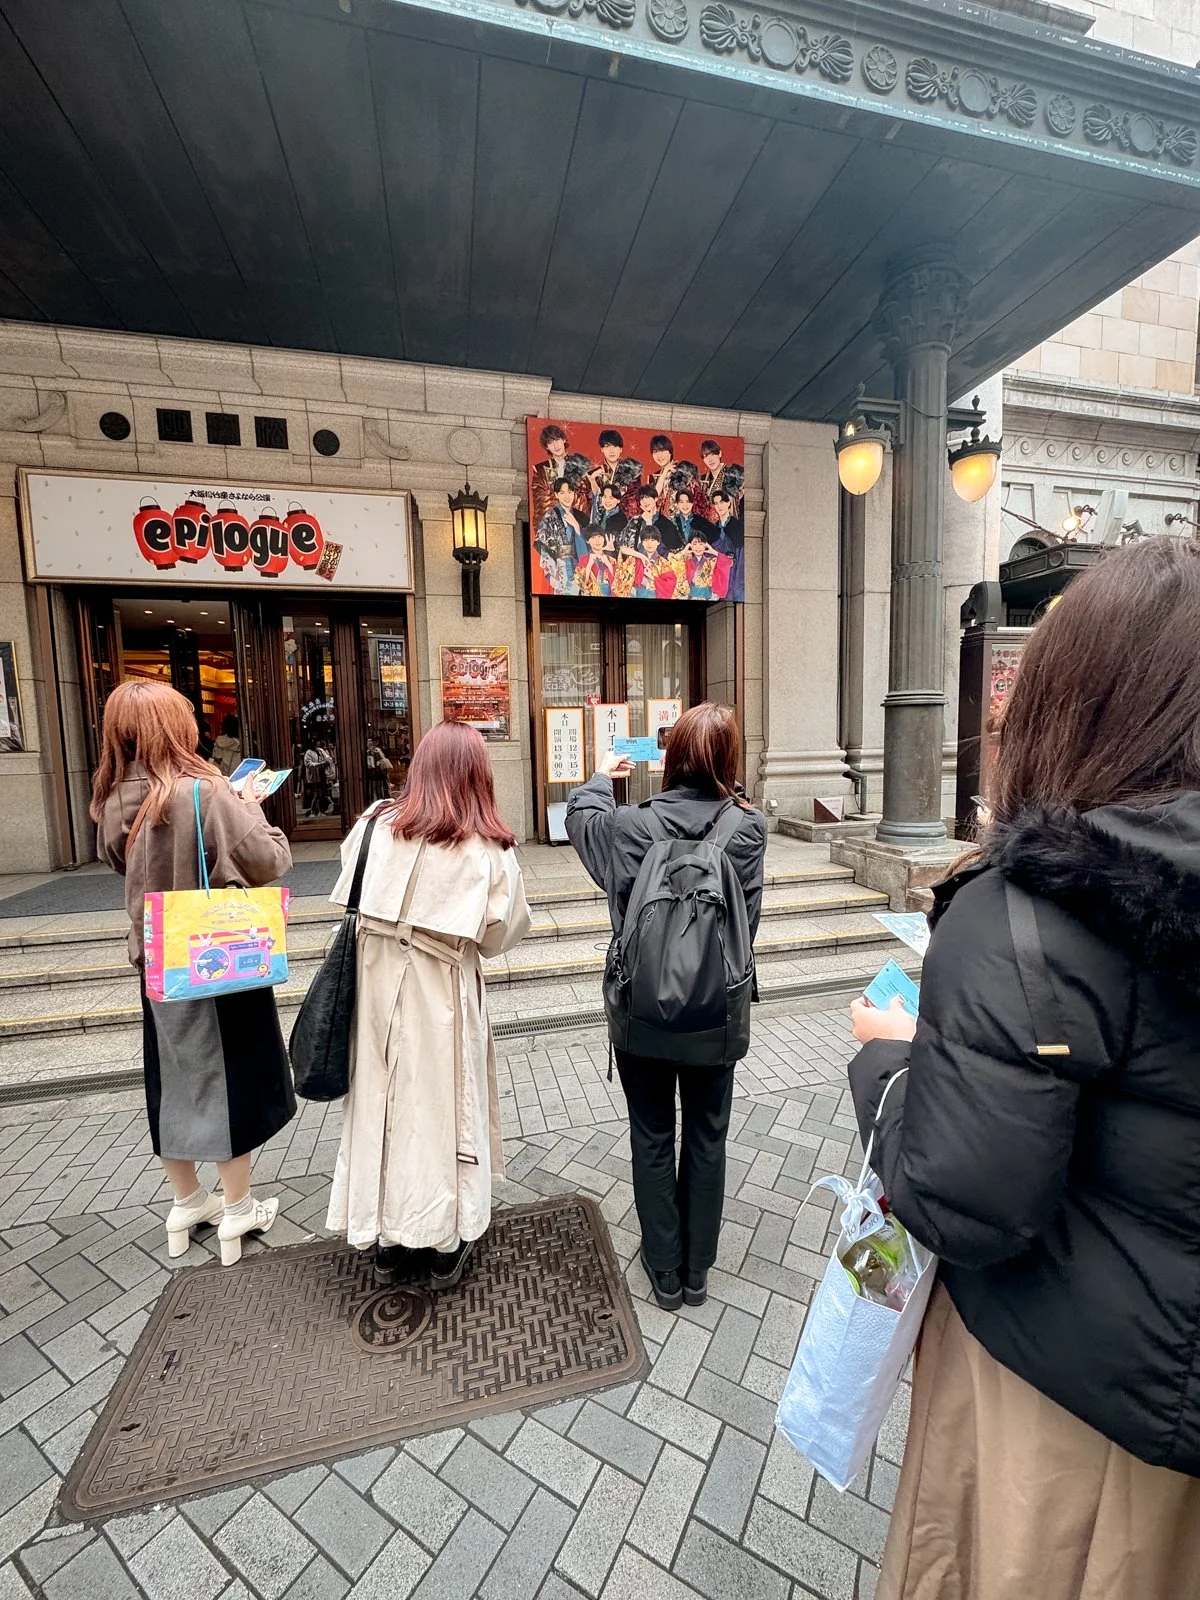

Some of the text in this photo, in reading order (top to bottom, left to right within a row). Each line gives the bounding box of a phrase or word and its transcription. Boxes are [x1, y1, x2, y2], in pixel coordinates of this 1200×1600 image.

[143, 514, 317, 567] epilogue
[560, 712, 569, 727] 本日
[372, 1326, 410, 1345] NTT
